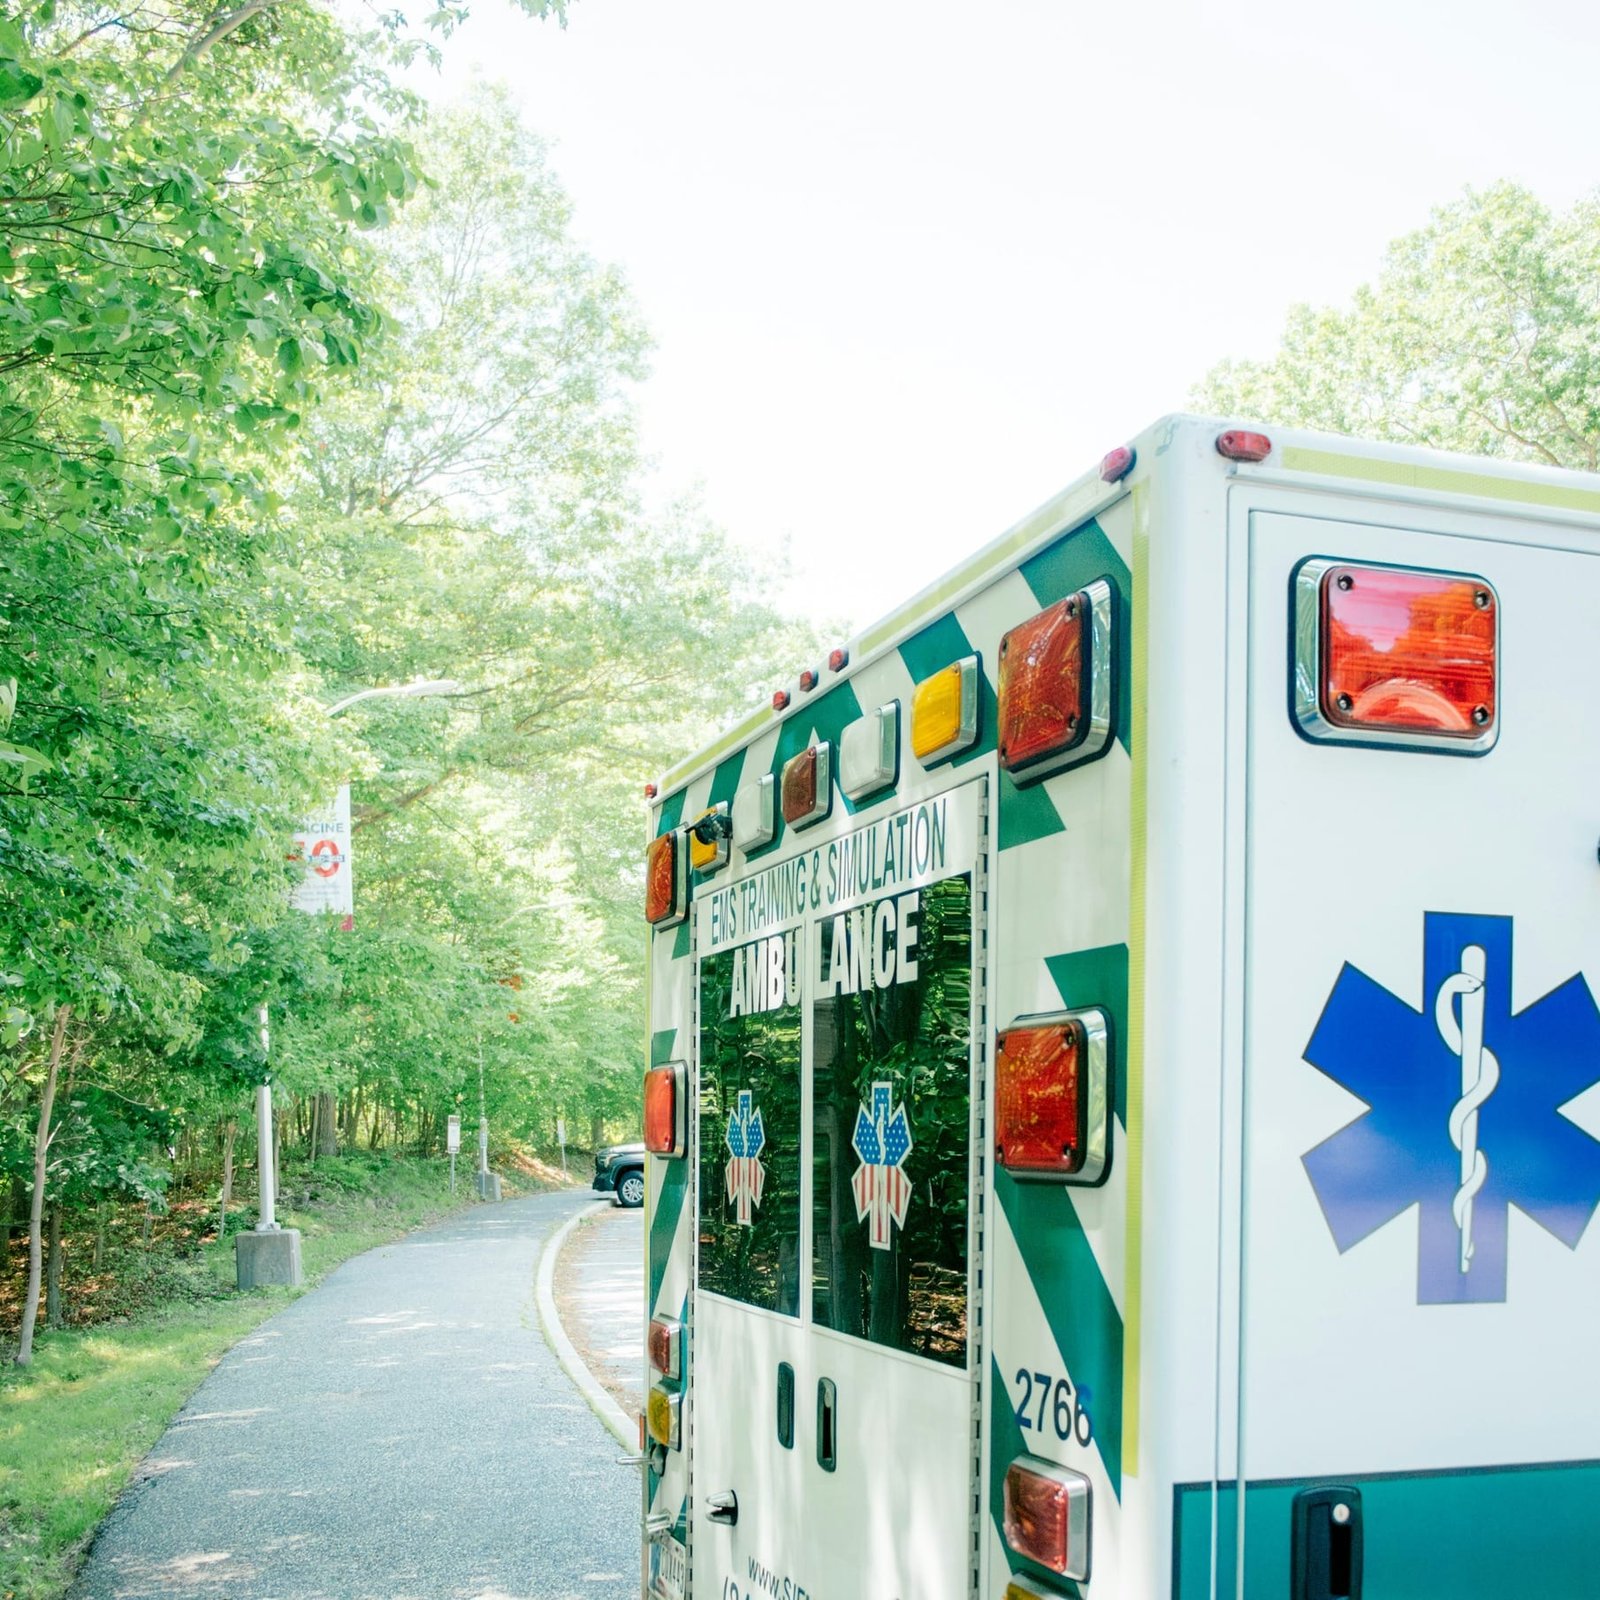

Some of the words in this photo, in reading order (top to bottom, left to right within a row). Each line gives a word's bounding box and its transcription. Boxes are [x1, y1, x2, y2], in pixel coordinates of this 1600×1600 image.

[711, 890, 737, 946] EMS
[741, 856, 806, 935] TRAINING
[810, 850, 821, 910] &
[827, 798, 946, 905] SIMULATION
[1015, 1368, 1094, 1448] 2766
